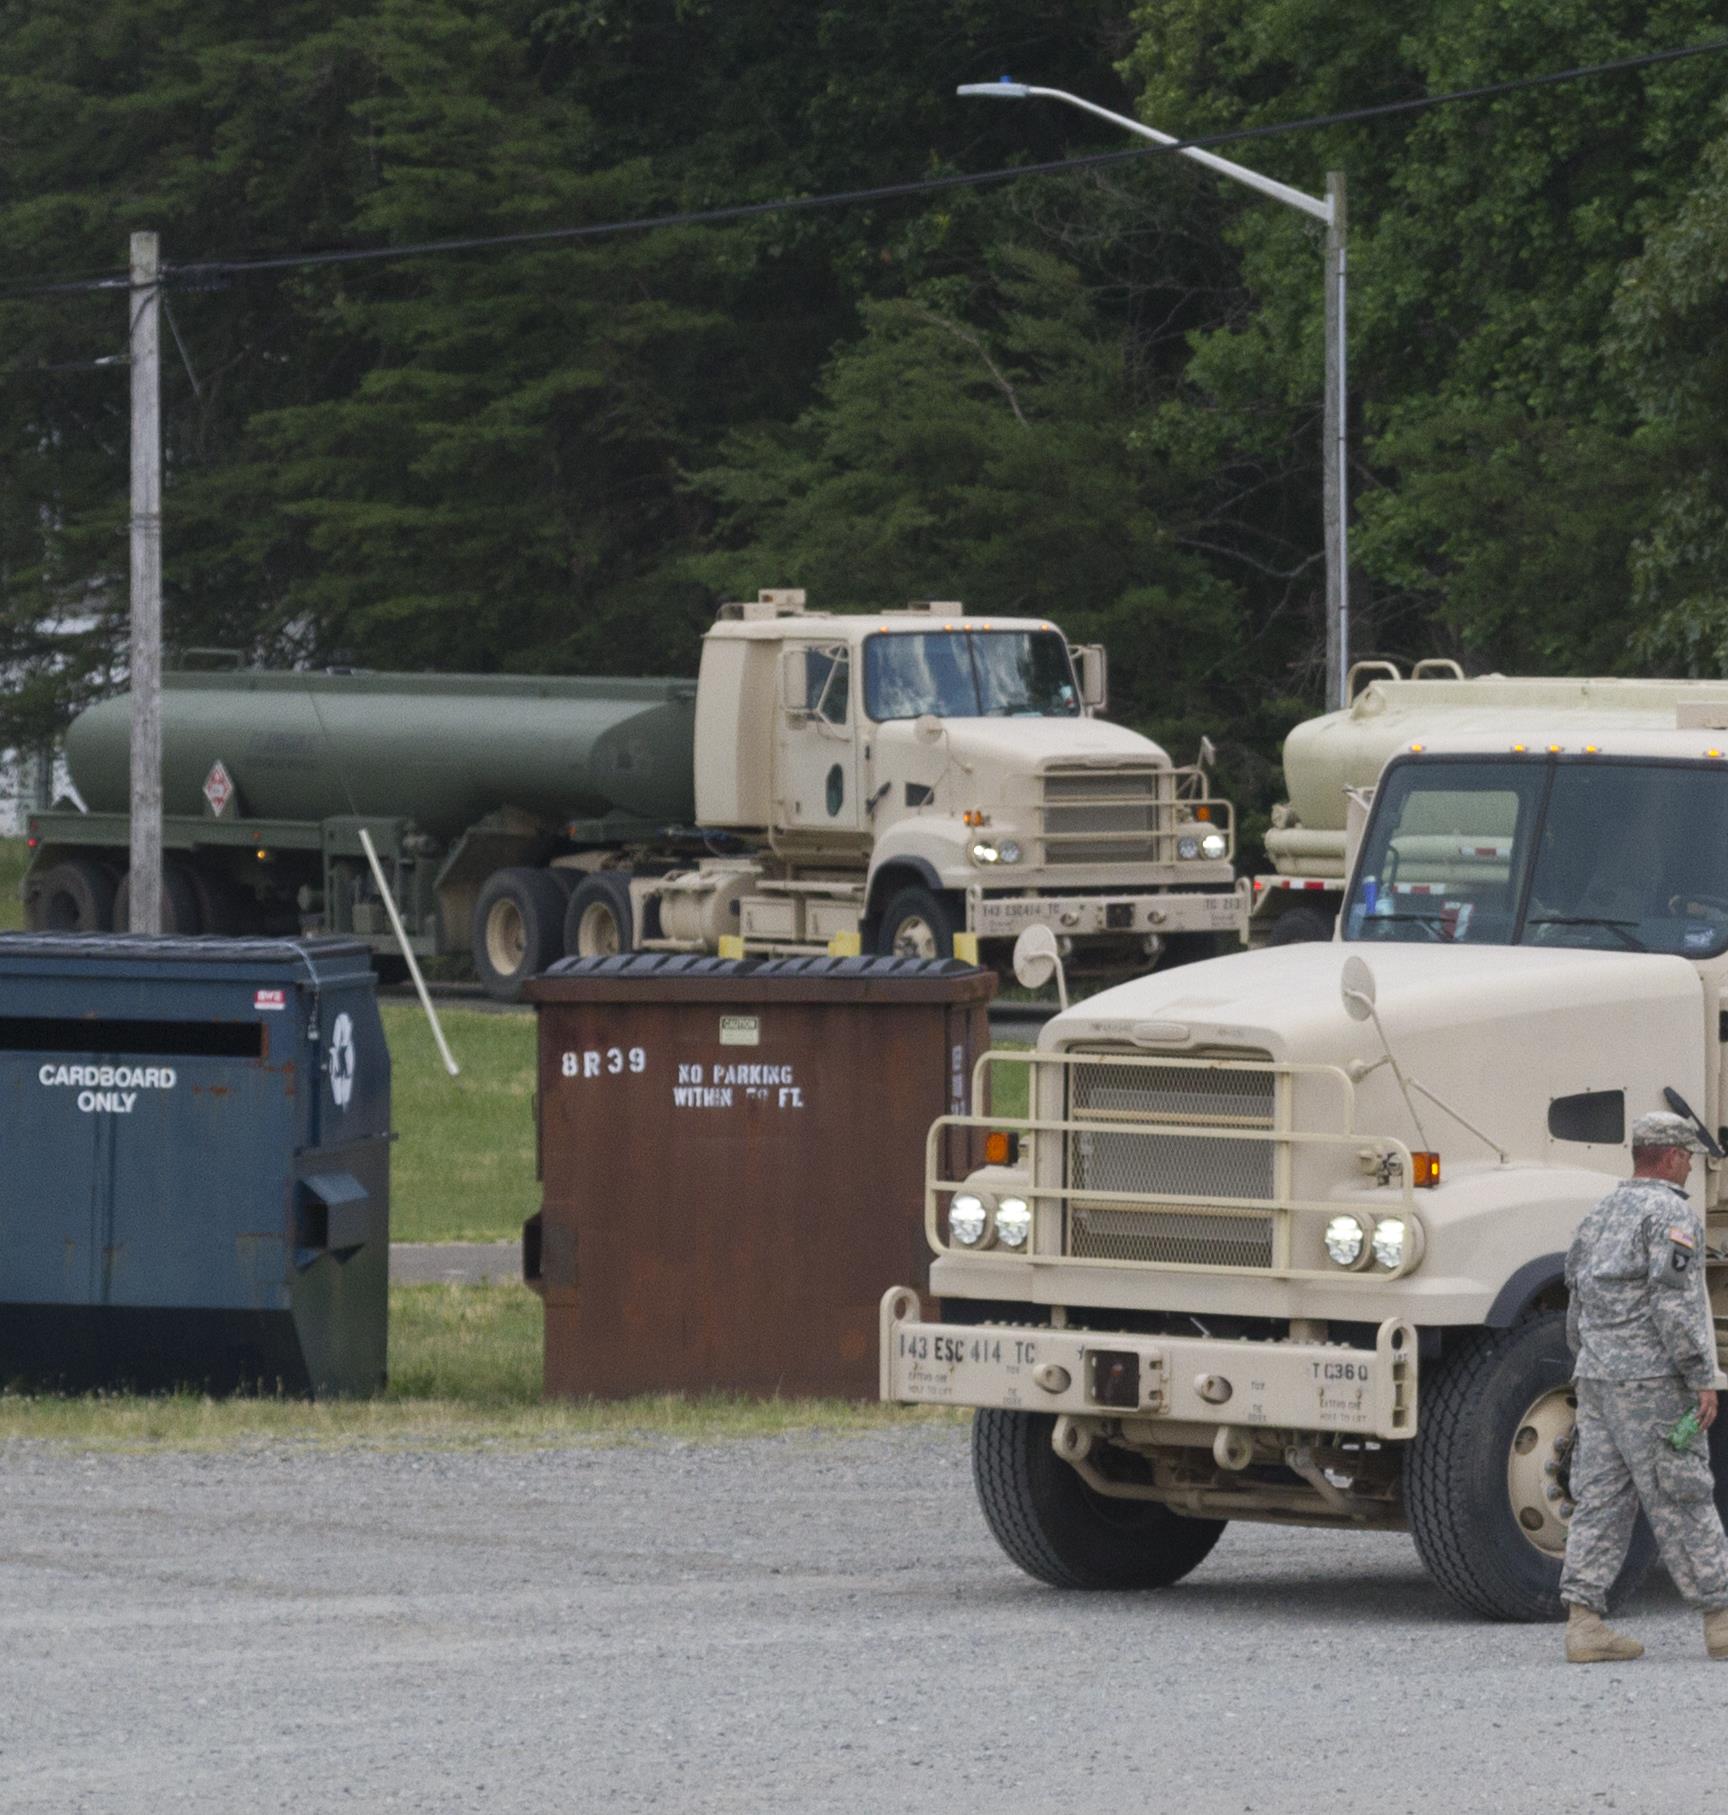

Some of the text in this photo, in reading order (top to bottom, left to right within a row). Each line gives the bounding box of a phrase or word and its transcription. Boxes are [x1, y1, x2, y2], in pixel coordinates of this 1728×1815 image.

[38, 1064, 177, 1089] CARDBOARD
[678, 1065, 793, 1084] NO PARKING
[77, 1091, 137, 1113] ONLY
[673, 1087, 732, 1107] WITHIN
[901, 1333, 1036, 1364] 143 ESC 414 TC
